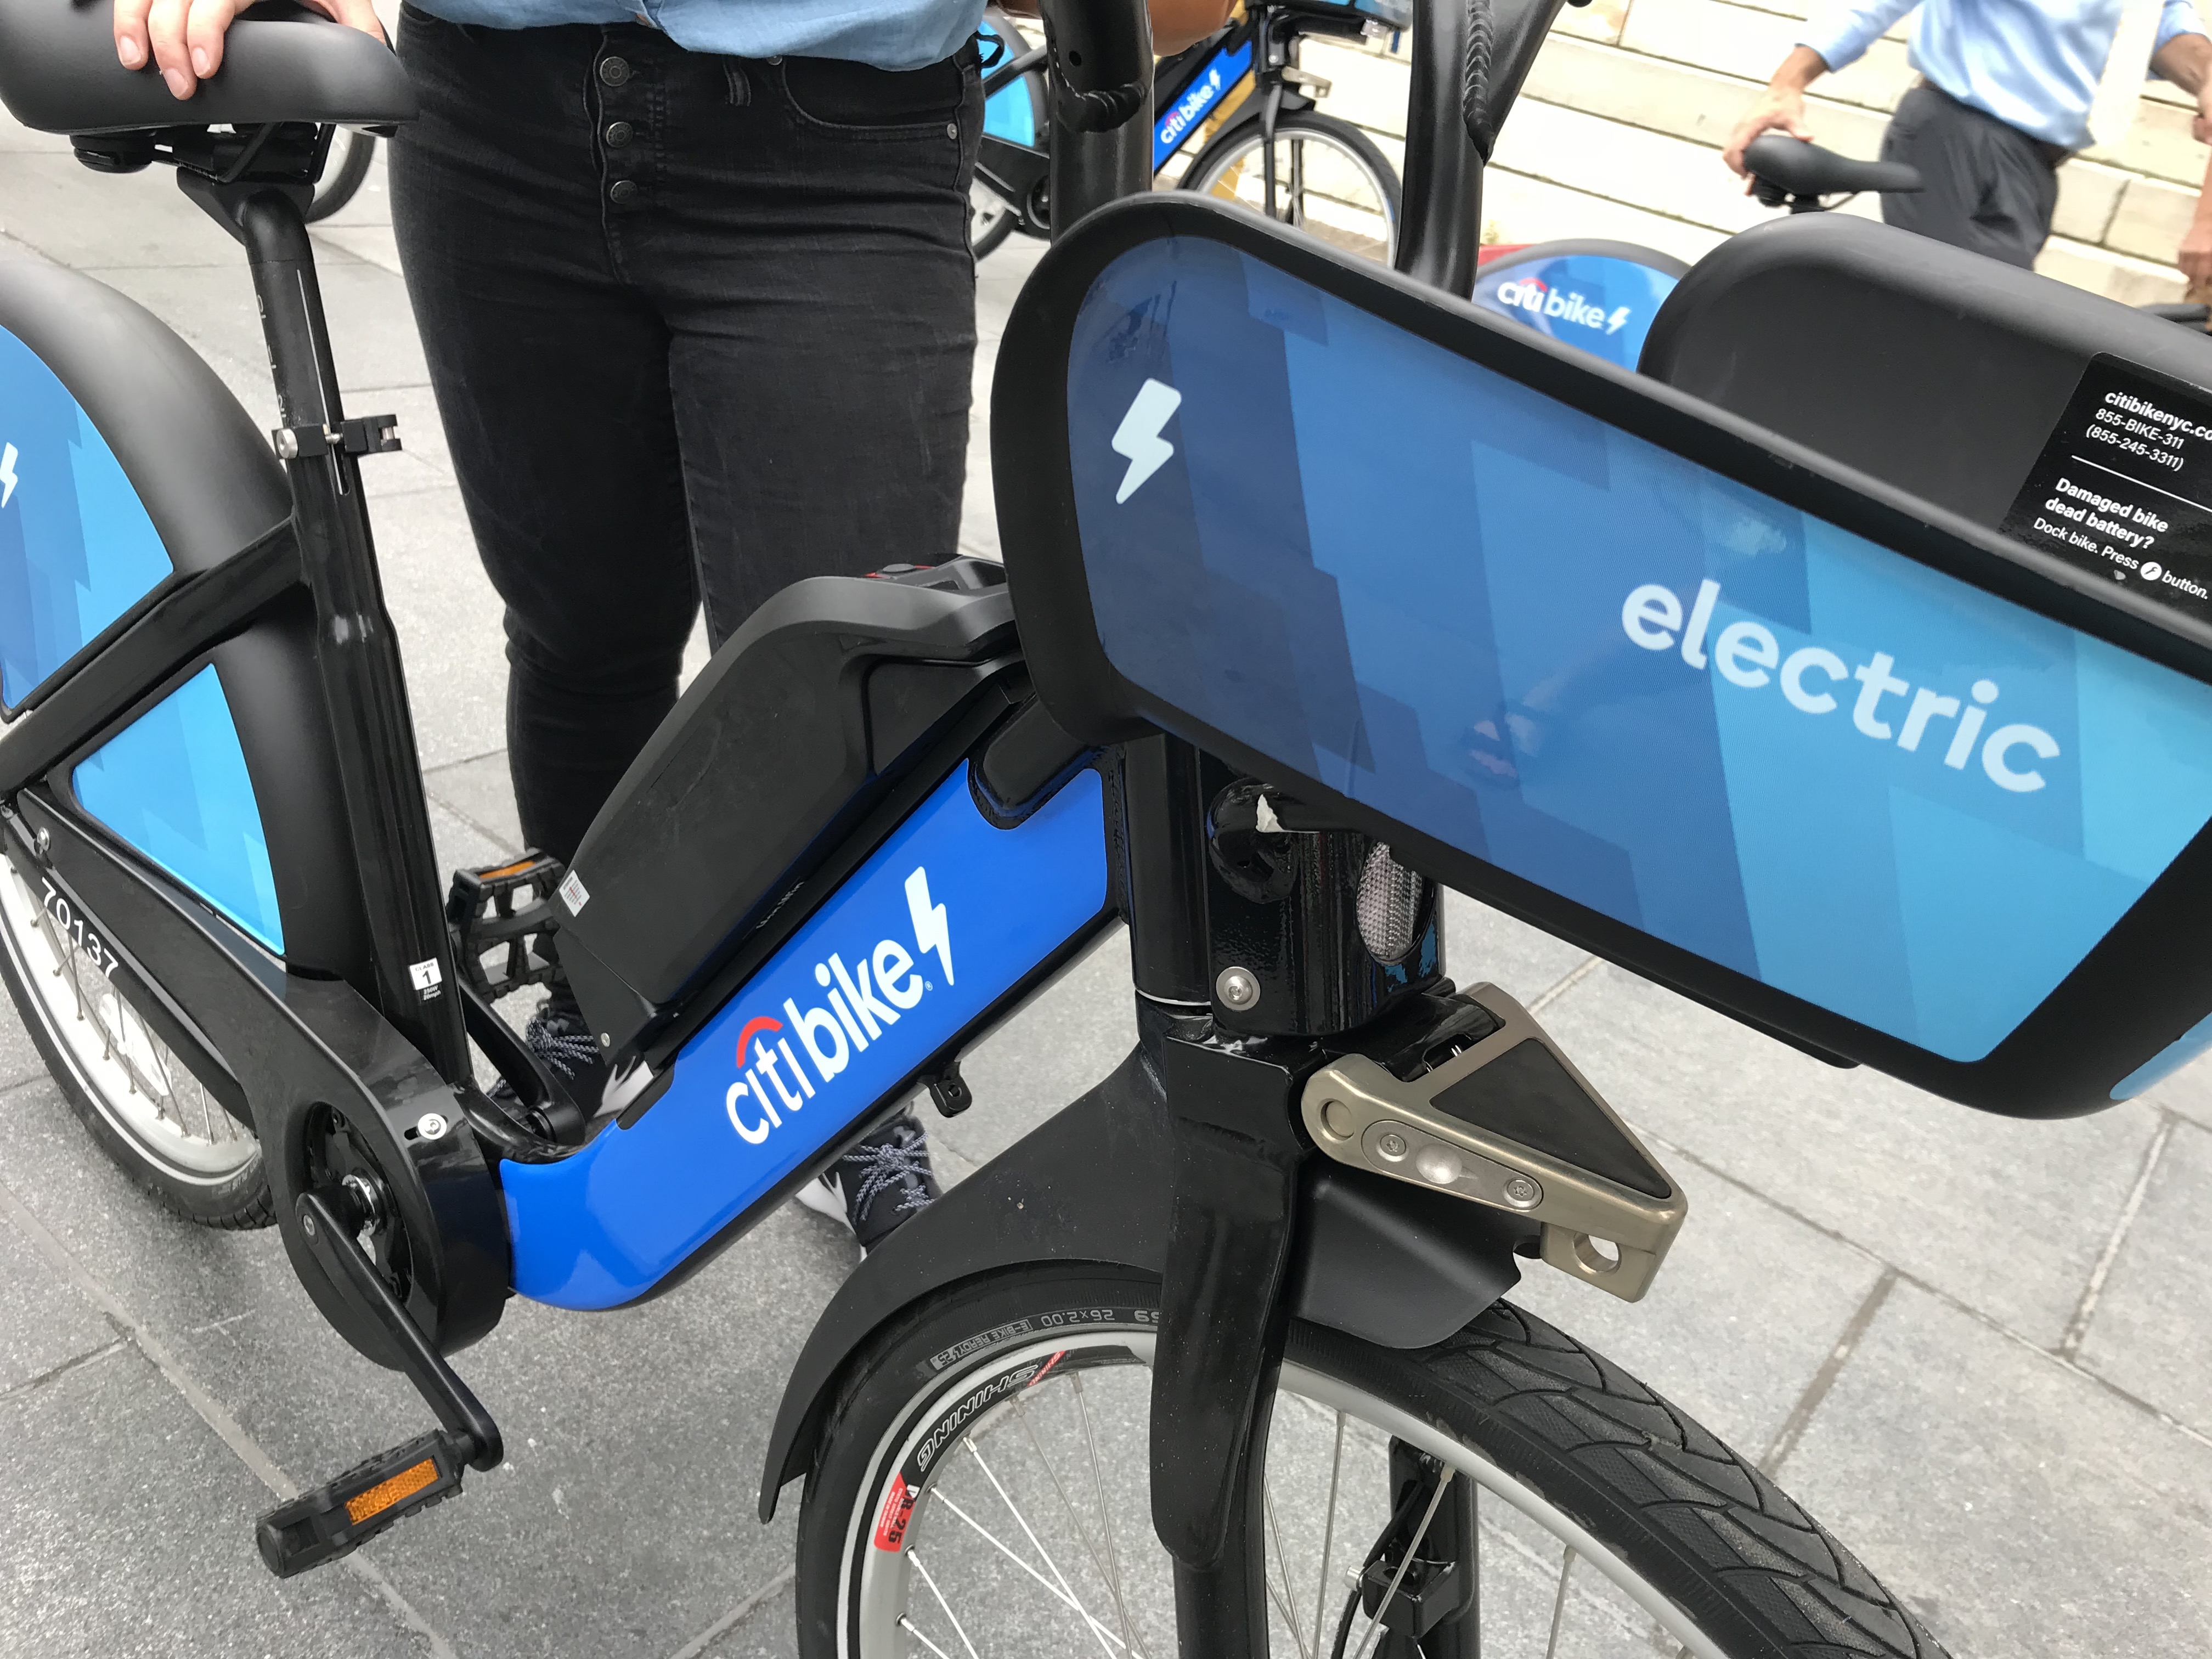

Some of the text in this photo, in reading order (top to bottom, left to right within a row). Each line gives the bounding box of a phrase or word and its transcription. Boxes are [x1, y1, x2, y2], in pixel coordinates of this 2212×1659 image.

[1160, 85, 1214, 144] citi bike
[1497, 278, 1605, 329] citi bike
[2095, 408, 2185, 449] 855-BIKE-311
[2104, 392, 2212, 441] citibikenyc.co
[2086, 424, 2184, 471] (855-245-3311)
[2045, 497, 2154, 549] dead battery?
[2056, 478, 2169, 533] Damaged bike
[2034, 517, 2208, 600] Dock bike. Press button.
[1622, 579, 2061, 793] electric
[42, 876, 119, 979] 70137
[422, 970, 432, 985] 1
[726, 939, 923, 1144] citi bike
[937, 1321, 1029, 1366] E-BIKE READY 25
[1041, 1309, 1115, 1327] 26x2.00
[917, 1364, 1039, 1472] SHINING
